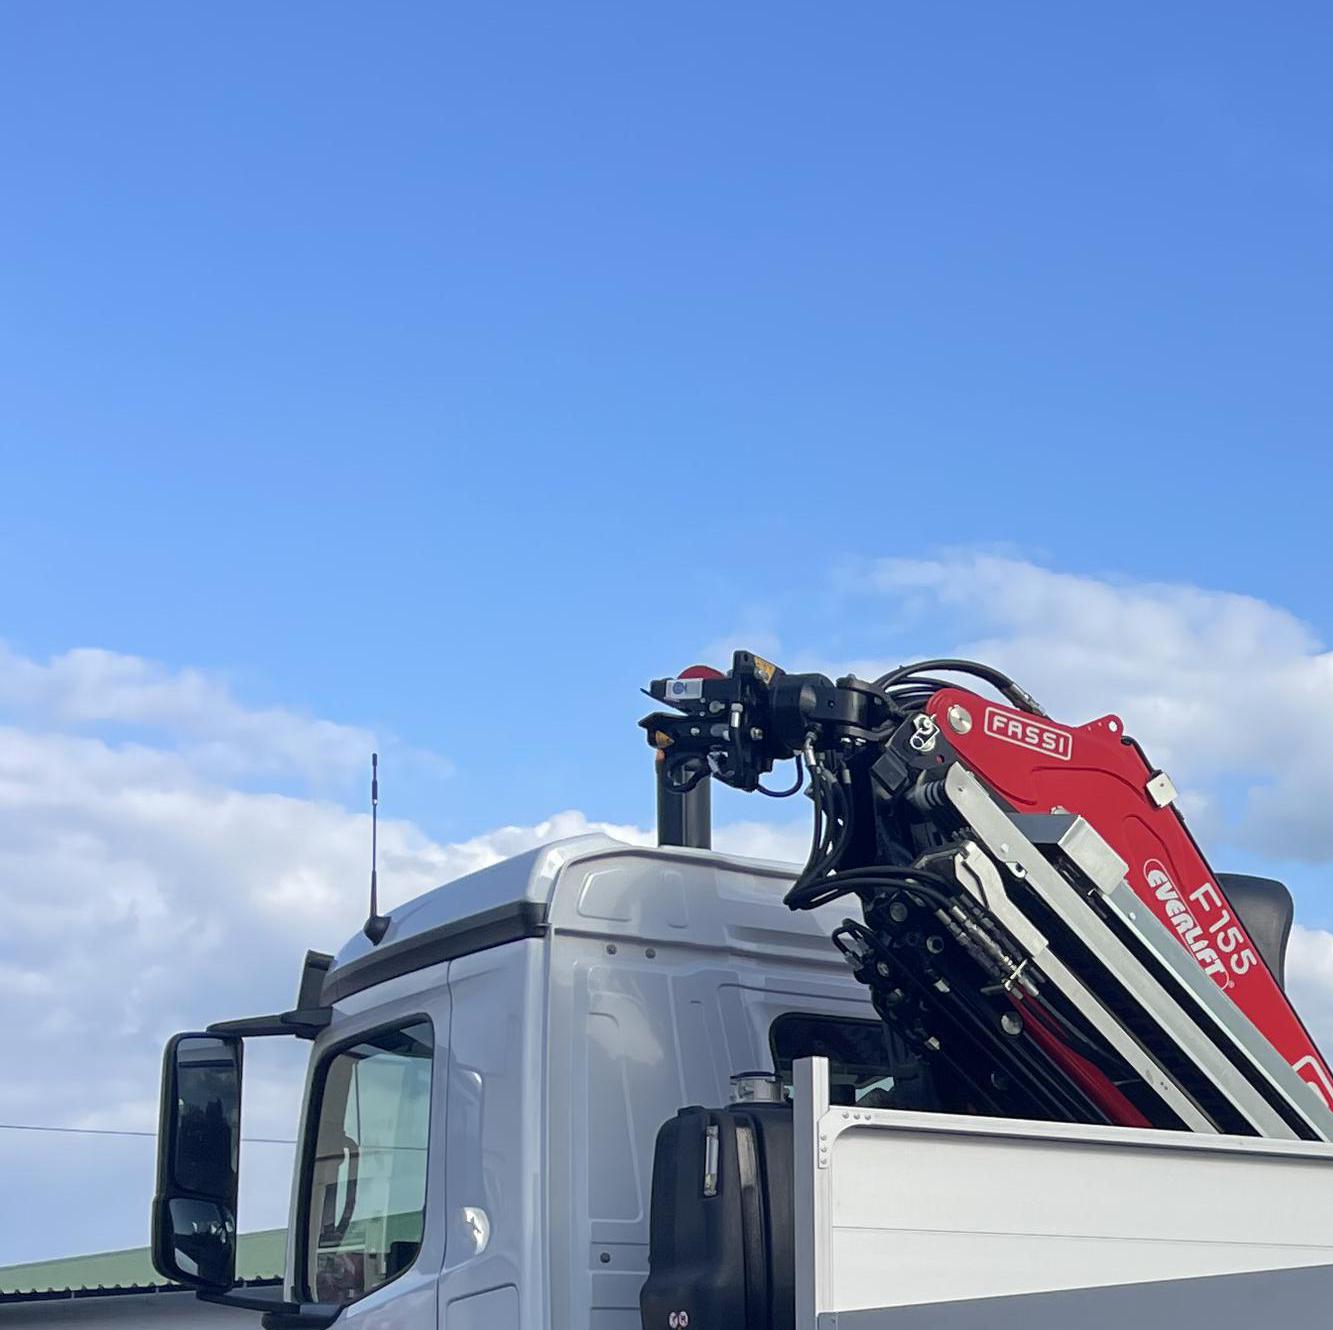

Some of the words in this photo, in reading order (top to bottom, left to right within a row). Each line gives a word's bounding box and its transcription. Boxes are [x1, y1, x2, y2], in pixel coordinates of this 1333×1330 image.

[992, 715, 1065, 753] FASSI
[1147, 869, 1225, 977] EVERLIFT
[1189, 882, 1258, 975] F155
